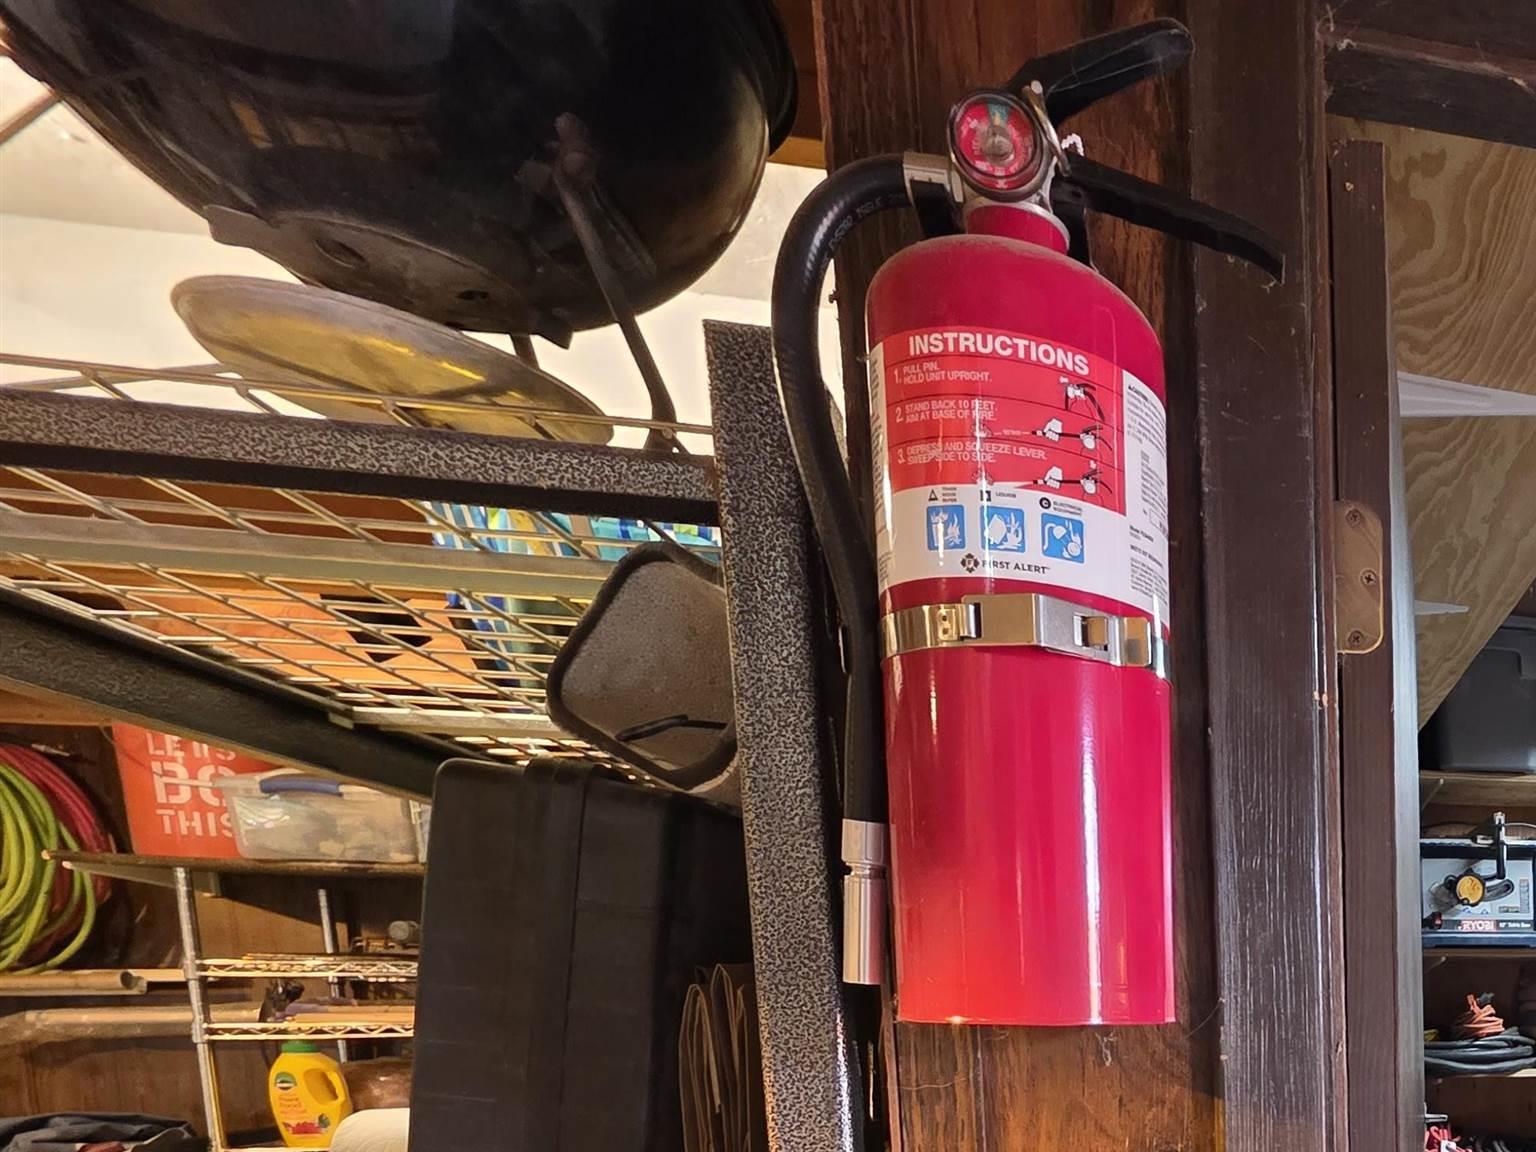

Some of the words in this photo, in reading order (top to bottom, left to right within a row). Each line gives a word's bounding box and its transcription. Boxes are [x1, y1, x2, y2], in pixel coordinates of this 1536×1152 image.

[909, 332, 1089, 375] INSTRUCTIONS
[903, 364, 921, 374] PULL
[904, 373, 925, 385] HOLD
[926, 371, 946, 382] UNIT
[947, 371, 992, 382] UPRIGHT.
[905, 401, 930, 414] STAND
[931, 400, 956, 410] BACK
[959, 400, 969, 409] 10
[906, 413, 920, 423] AIM
[921, 411, 931, 420] AT
[932, 410, 956, 419] BASE
[957, 409, 970, 418] OF
[907, 443, 942, 455] DEPRESS
[944, 442, 963, 451] AND
[965, 442, 1013, 454] SQUEEZE
[907, 453, 936, 464] SWEEP
[935, 452, 956, 462] SIDE
[957, 451, 969, 460] TO
[982, 560, 1010, 570] FIRST
[1013, 561, 1048, 574] ALERT
[155, 809, 233, 837] THIS
[1461, 920, 1494, 930] RYOBI
